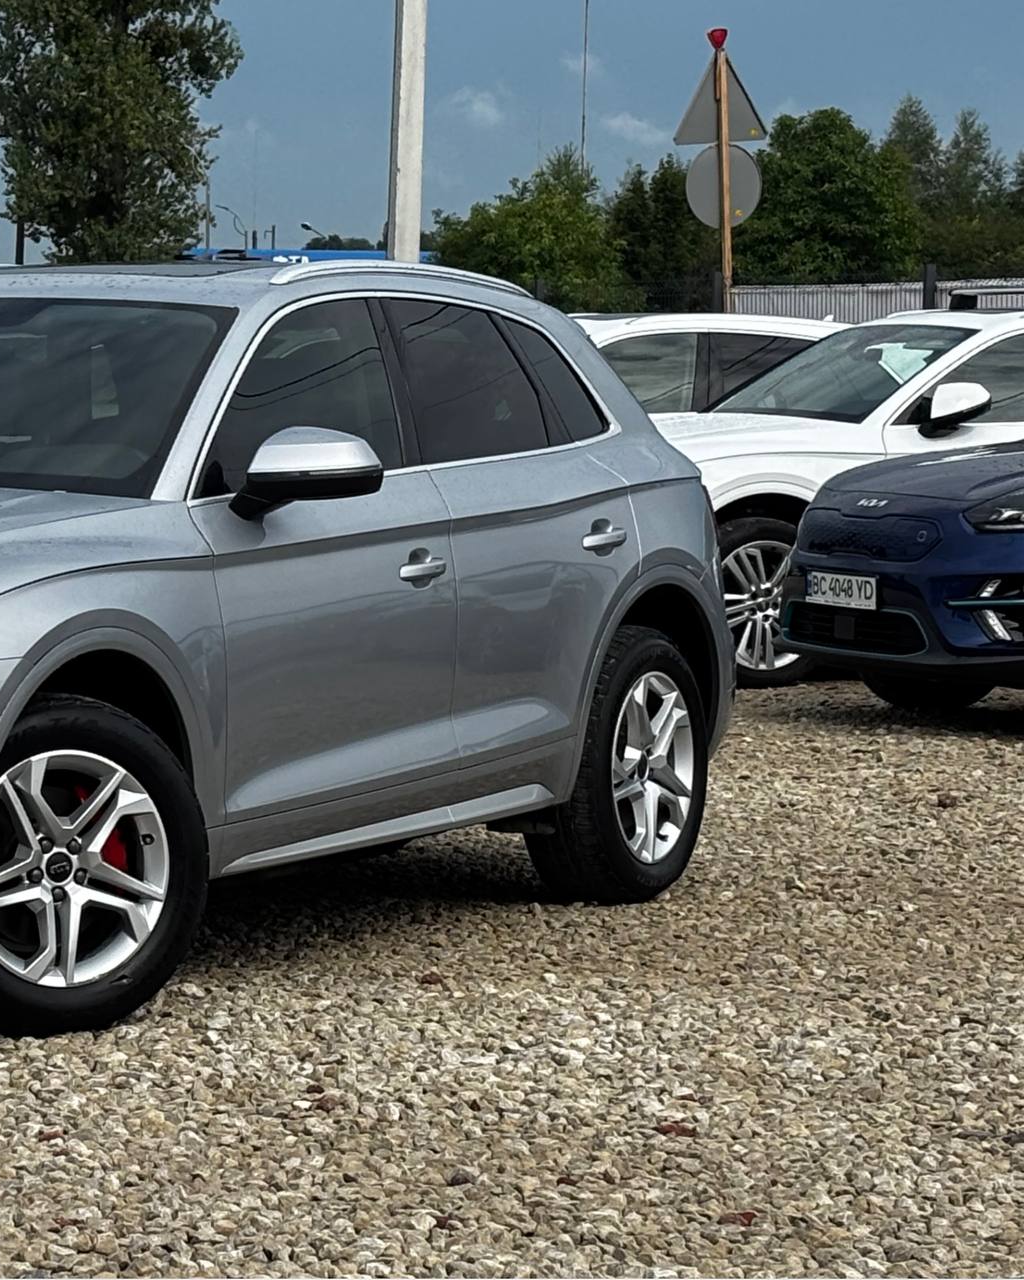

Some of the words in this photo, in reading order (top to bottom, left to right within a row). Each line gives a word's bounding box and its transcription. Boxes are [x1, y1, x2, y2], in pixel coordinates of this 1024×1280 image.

[857, 498, 888, 508] KIA
[812, 575, 827, 596] BC
[829, 577, 853, 598] 4048
[856, 579, 873, 599] YD
